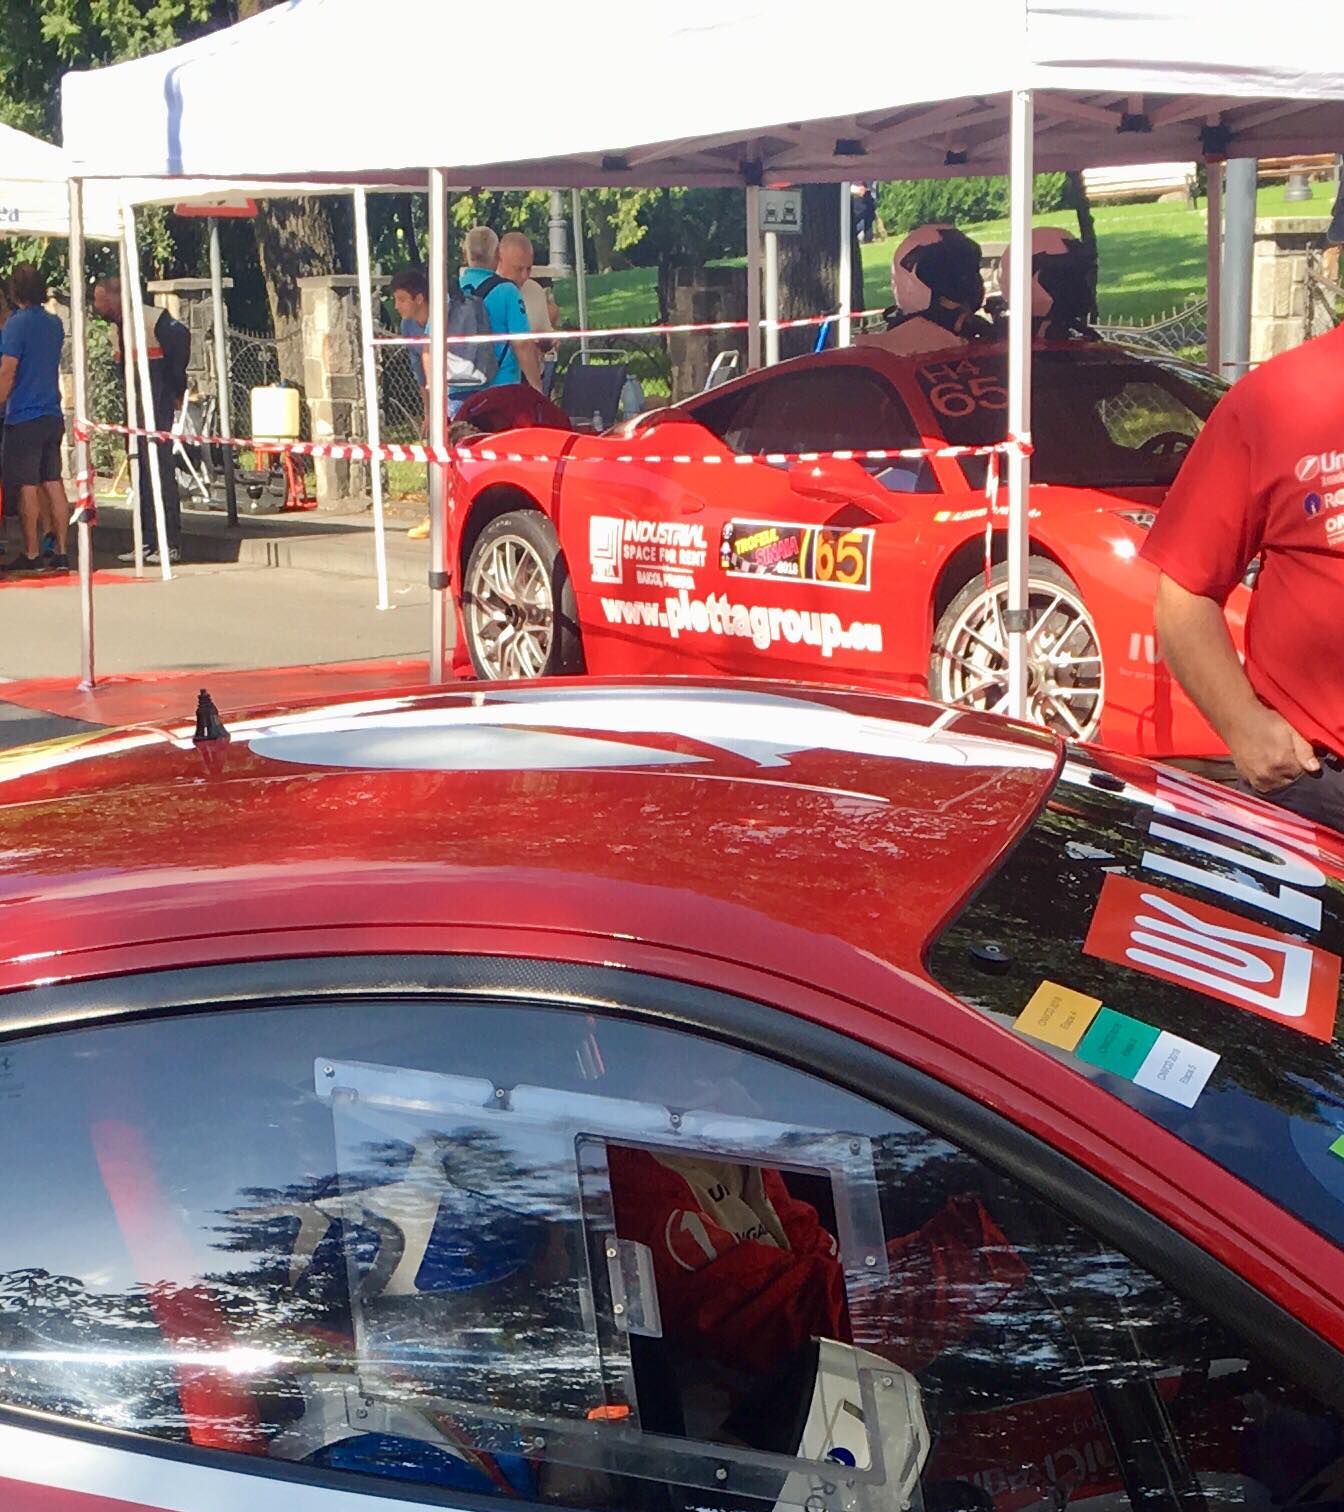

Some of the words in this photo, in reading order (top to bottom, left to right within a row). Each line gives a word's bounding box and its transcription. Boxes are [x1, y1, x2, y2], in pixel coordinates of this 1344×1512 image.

[930, 376, 1009, 417] 65
[624, 519, 707, 548] INDUSTRIAL
[623, 544, 656, 561] SPACE
[816, 532, 864, 584] 65
